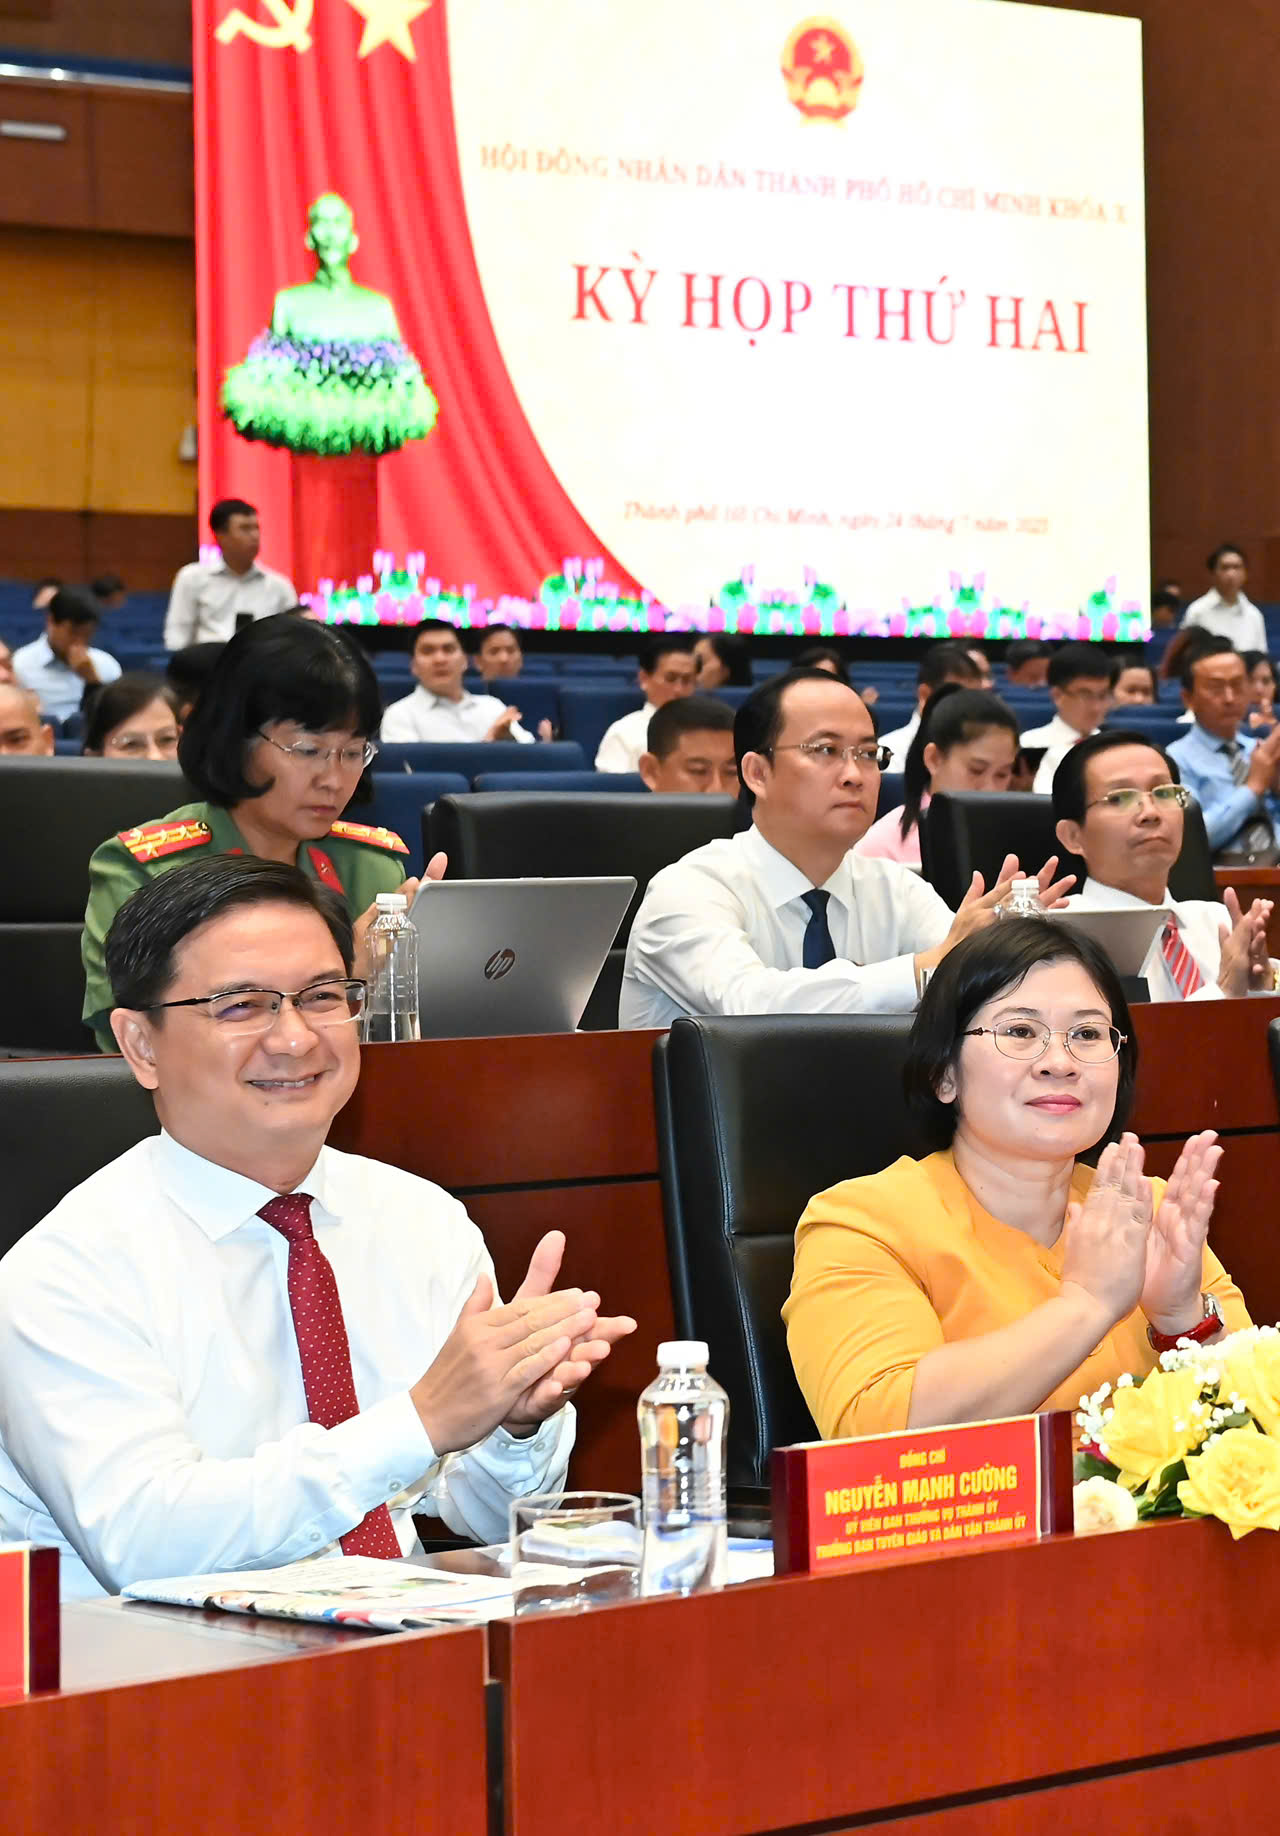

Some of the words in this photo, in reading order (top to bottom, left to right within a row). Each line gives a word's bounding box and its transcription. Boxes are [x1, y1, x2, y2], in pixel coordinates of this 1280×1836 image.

[571, 249, 658, 325] KỲ
[680, 271, 812, 348] HỌP
[832, 275, 967, 345] THỨ
[986, 294, 1089, 353] HAI
[484, 948, 516, 981] hp
[825, 1473, 898, 1516] NGUYỄN
[902, 1473, 955, 1507] MẠNH
[959, 1462, 1018, 1496] CƯỜNG
[883, 1514, 903, 1530] BAN
[854, 1539, 874, 1555] BAN
